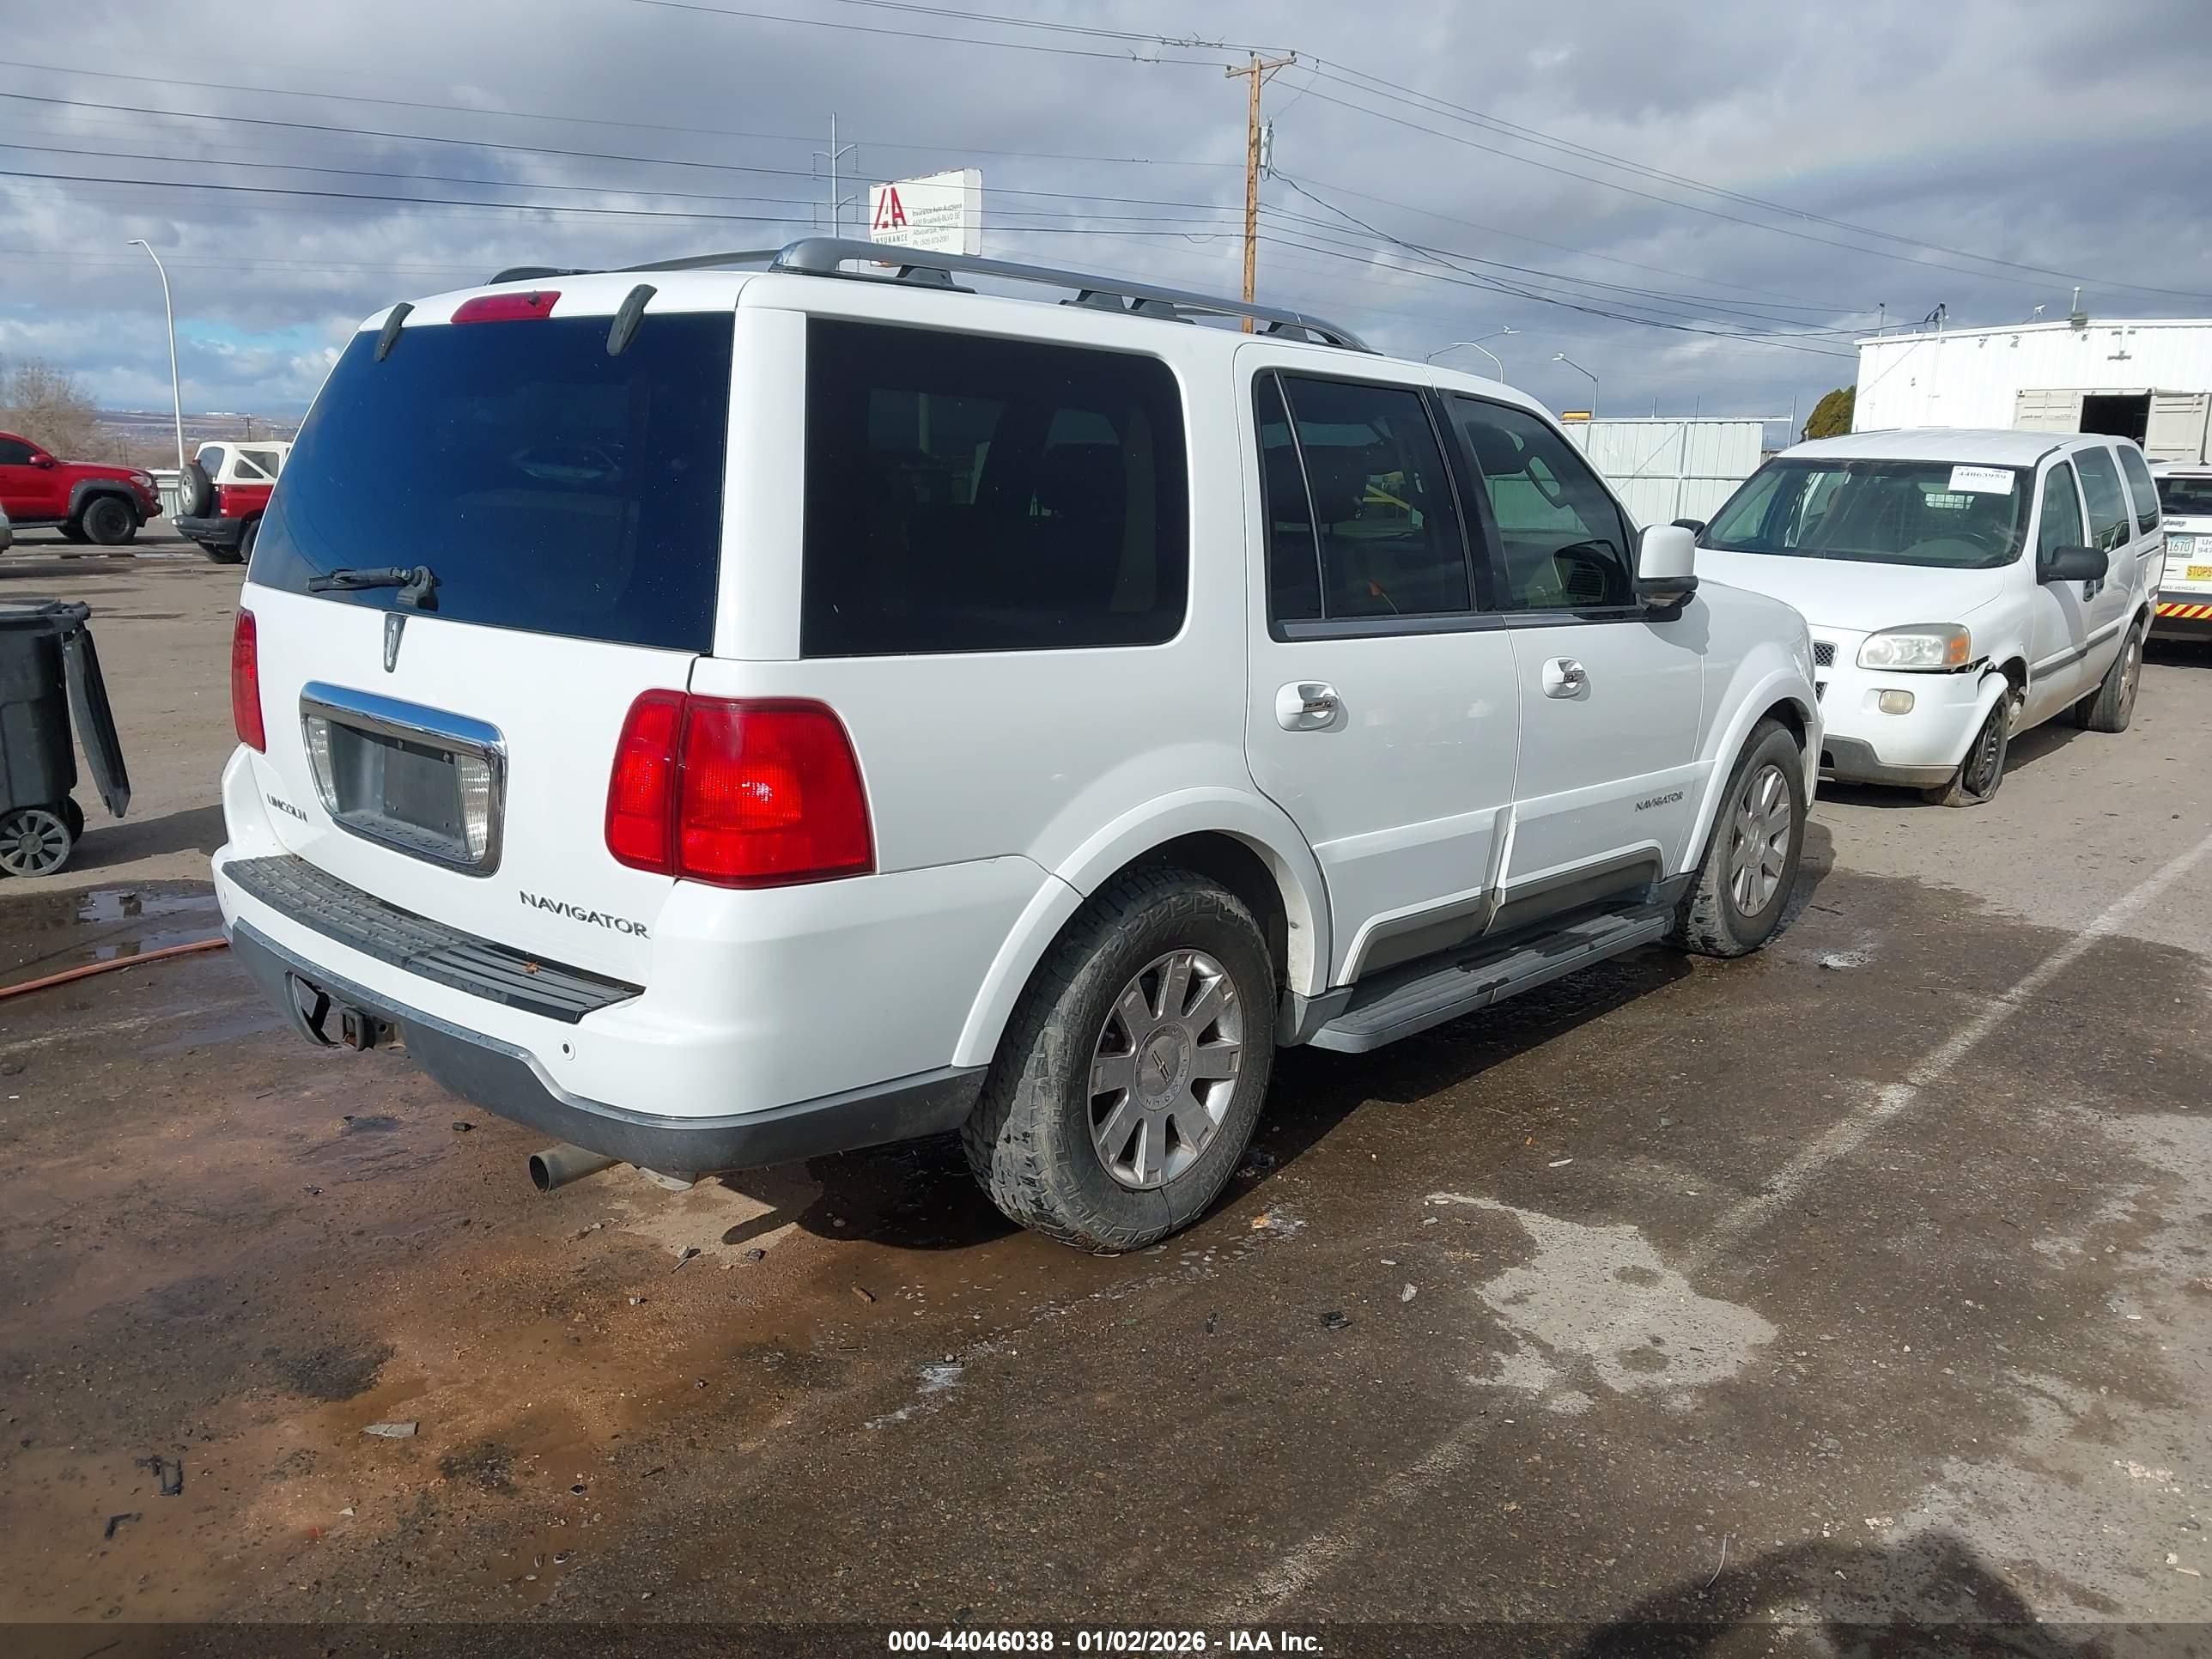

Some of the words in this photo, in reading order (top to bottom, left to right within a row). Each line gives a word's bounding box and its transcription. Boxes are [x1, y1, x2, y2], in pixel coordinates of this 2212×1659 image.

[2168, 541, 2191, 552] 1670
[266, 792, 308, 823] LINCOLN
[1634, 790, 1684, 812] NAVIGATOR
[519, 890, 651, 939] NAVIGATOR
